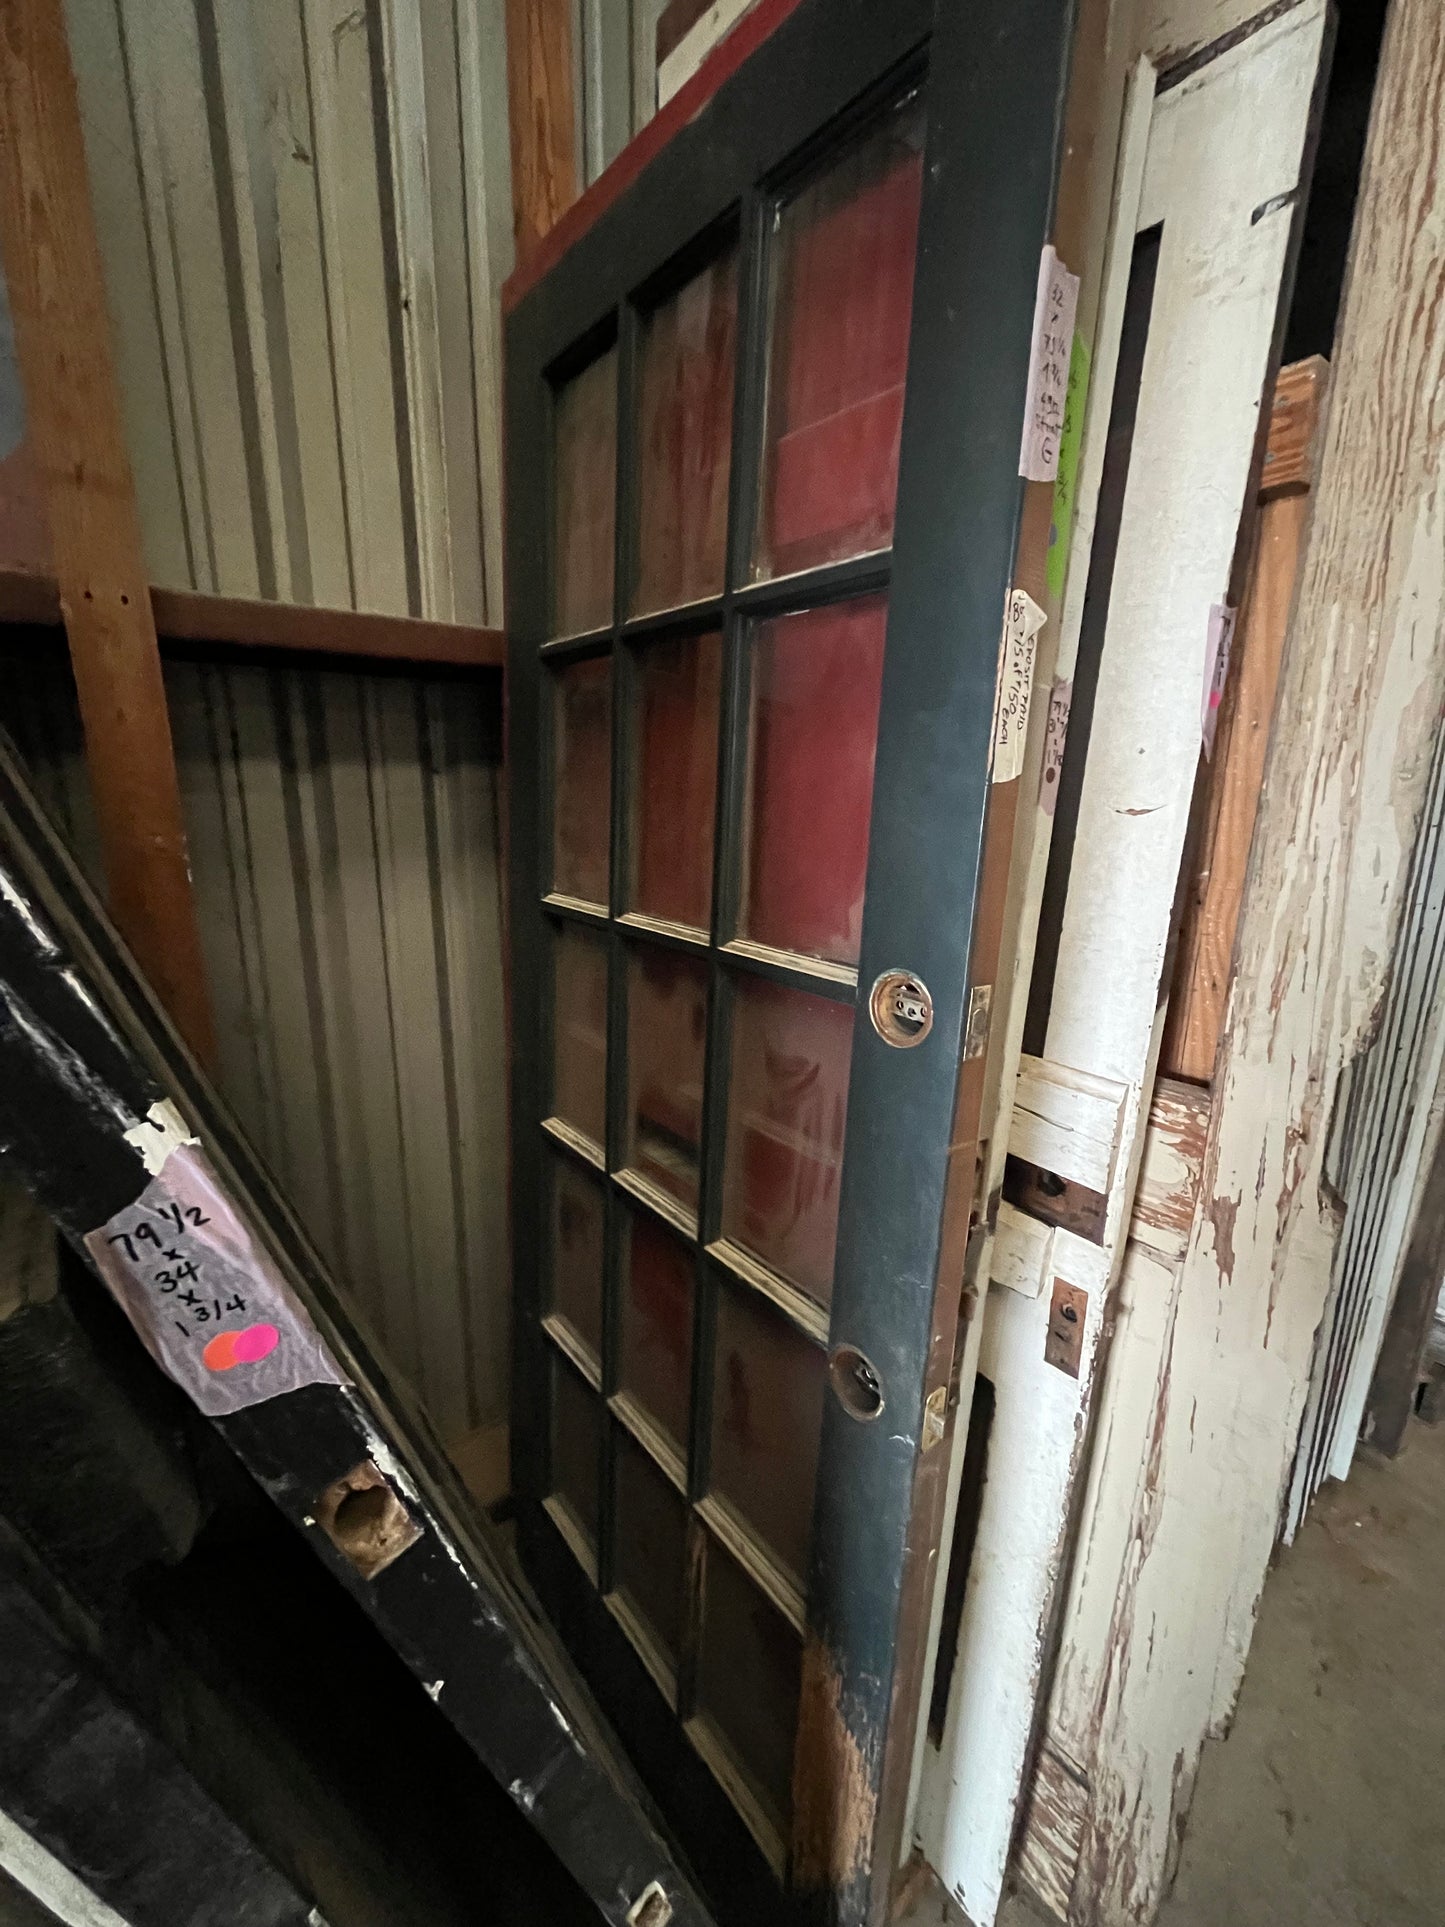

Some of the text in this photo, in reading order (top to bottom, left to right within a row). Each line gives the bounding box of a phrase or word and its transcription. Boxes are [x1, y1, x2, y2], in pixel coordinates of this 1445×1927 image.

[1021, 633, 1036, 690] EPOSIT
[107, 1202, 212, 1263] 79 1/2
[162, 1248, 186, 1262] x
[154, 1260, 201, 1293] 34
[174, 1292, 247, 1338] 1 3/4
[177, 1288, 203, 1308] x
